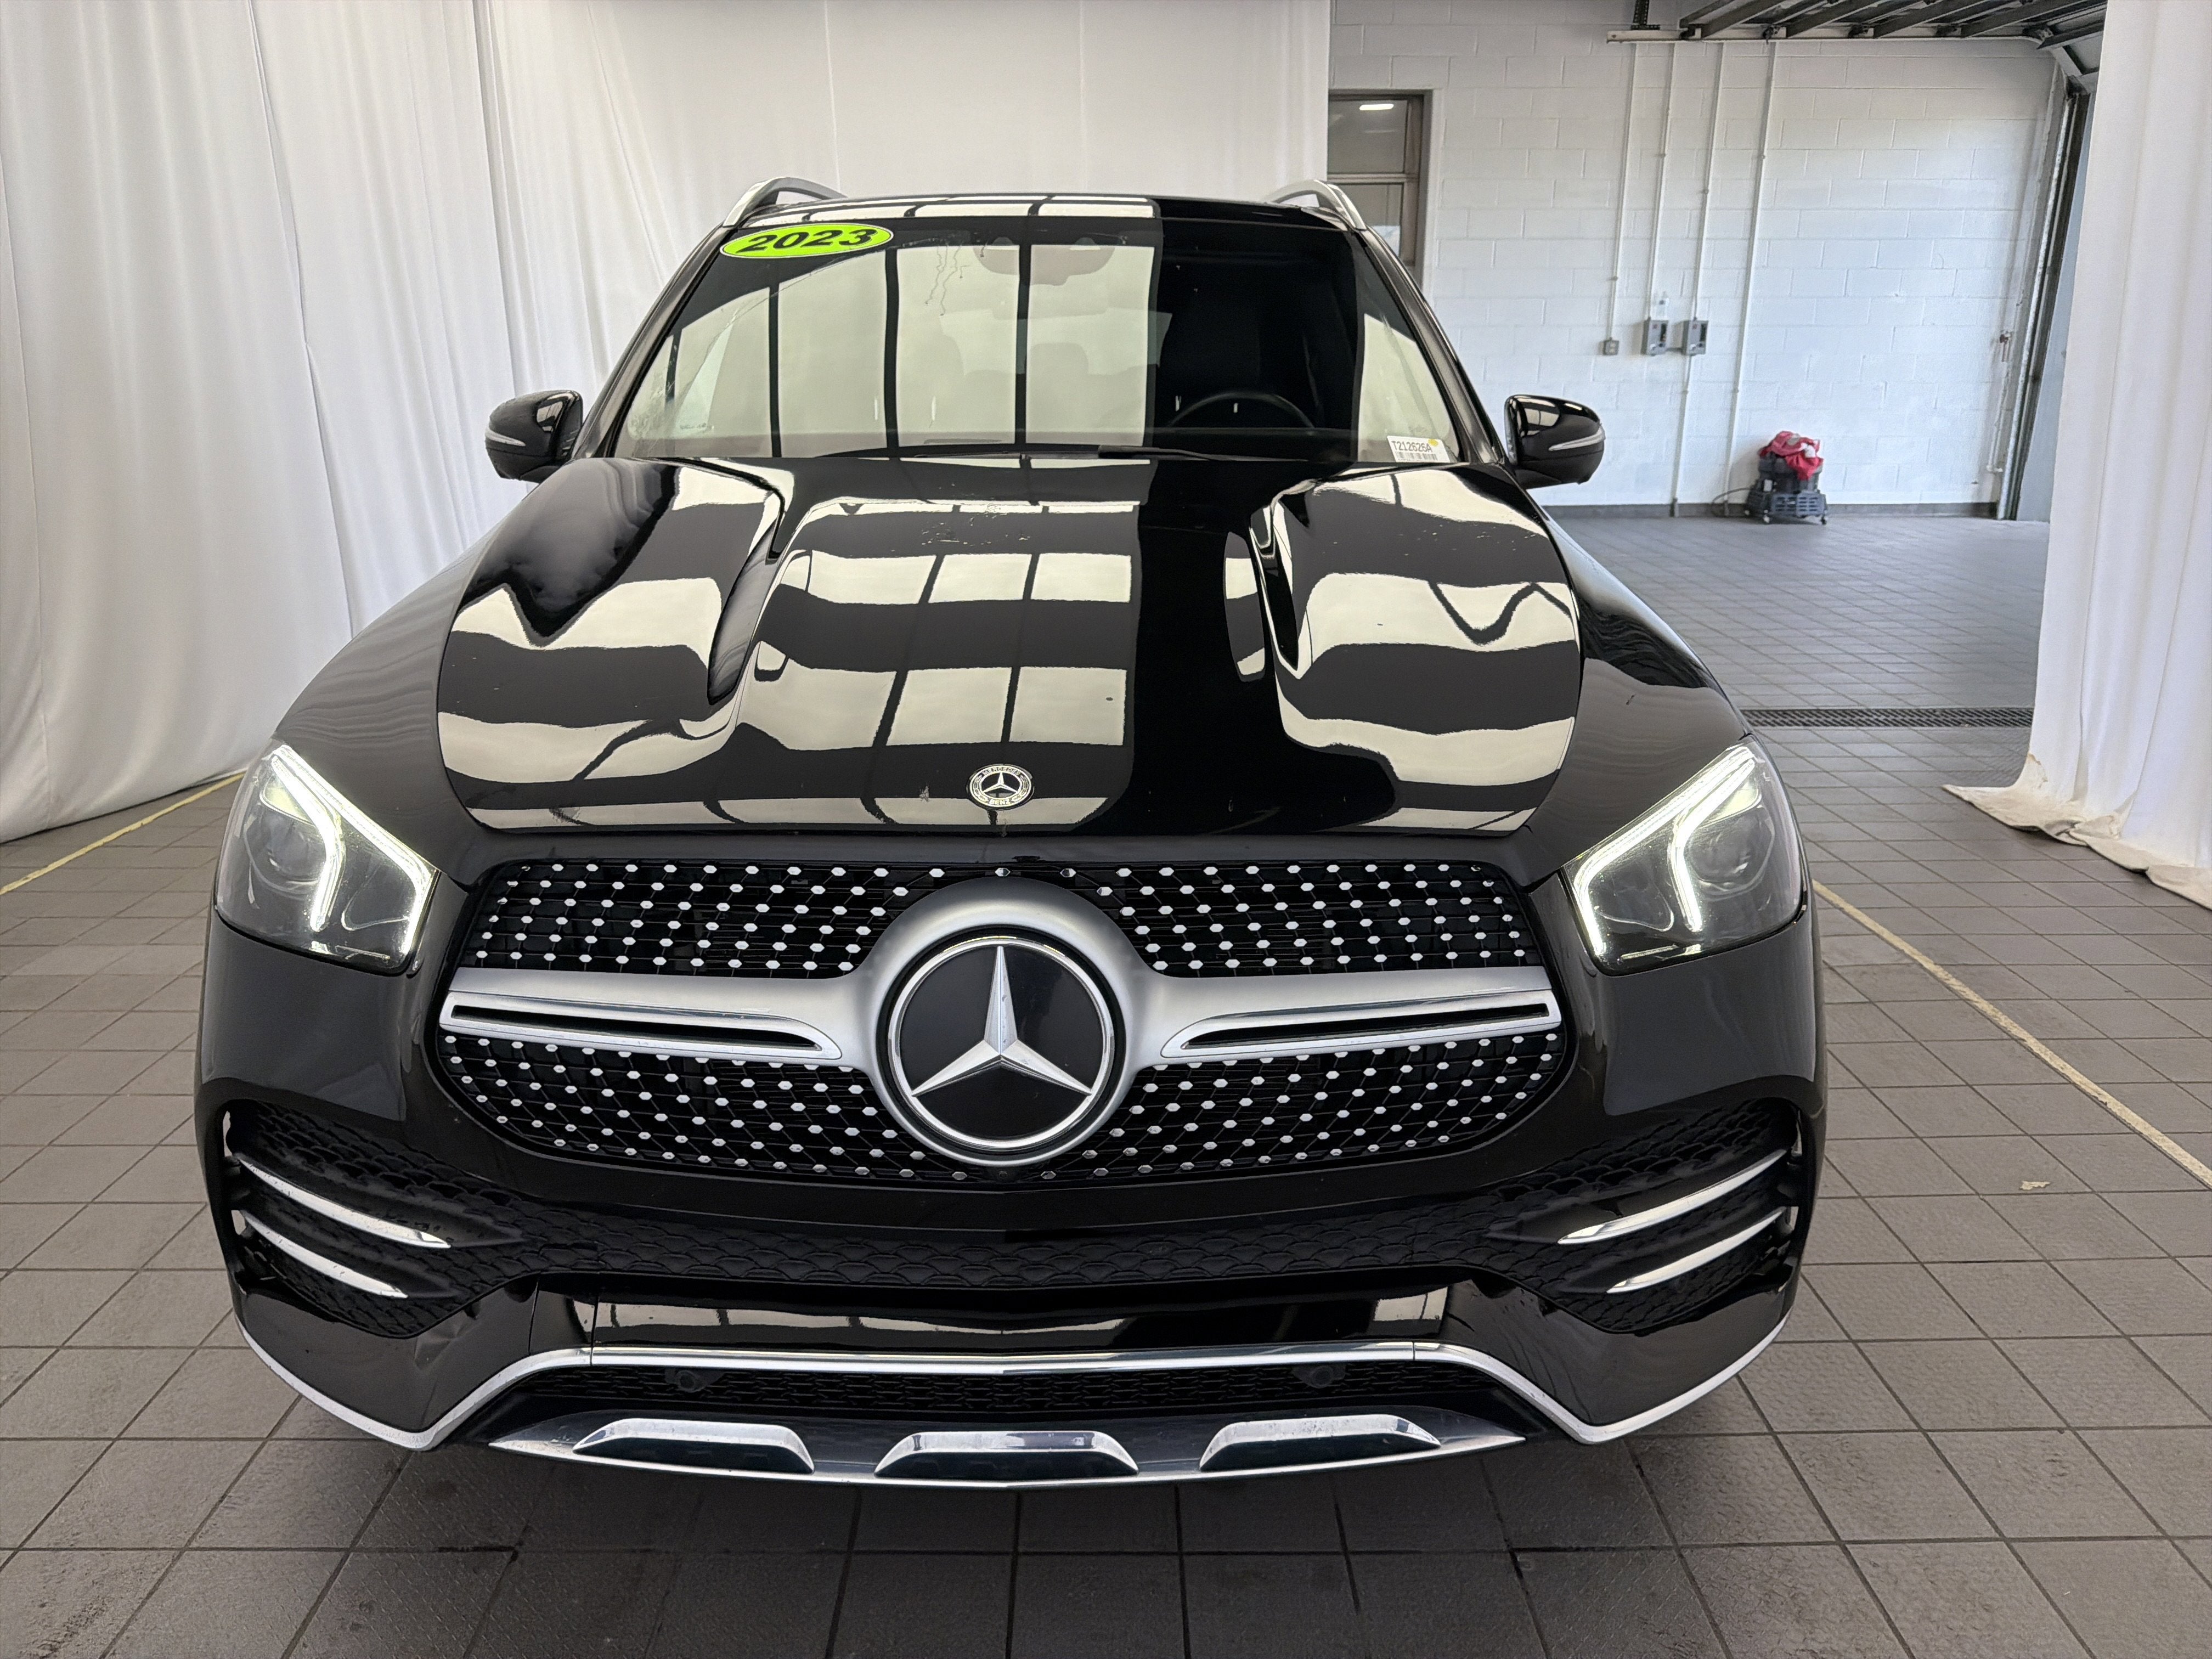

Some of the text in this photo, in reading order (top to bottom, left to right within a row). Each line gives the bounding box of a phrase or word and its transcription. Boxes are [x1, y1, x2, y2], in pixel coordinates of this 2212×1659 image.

[736, 229, 878, 253] 2023
[1391, 441, 1432, 453] T212626A
[982, 767, 1021, 775] MERCEDES
